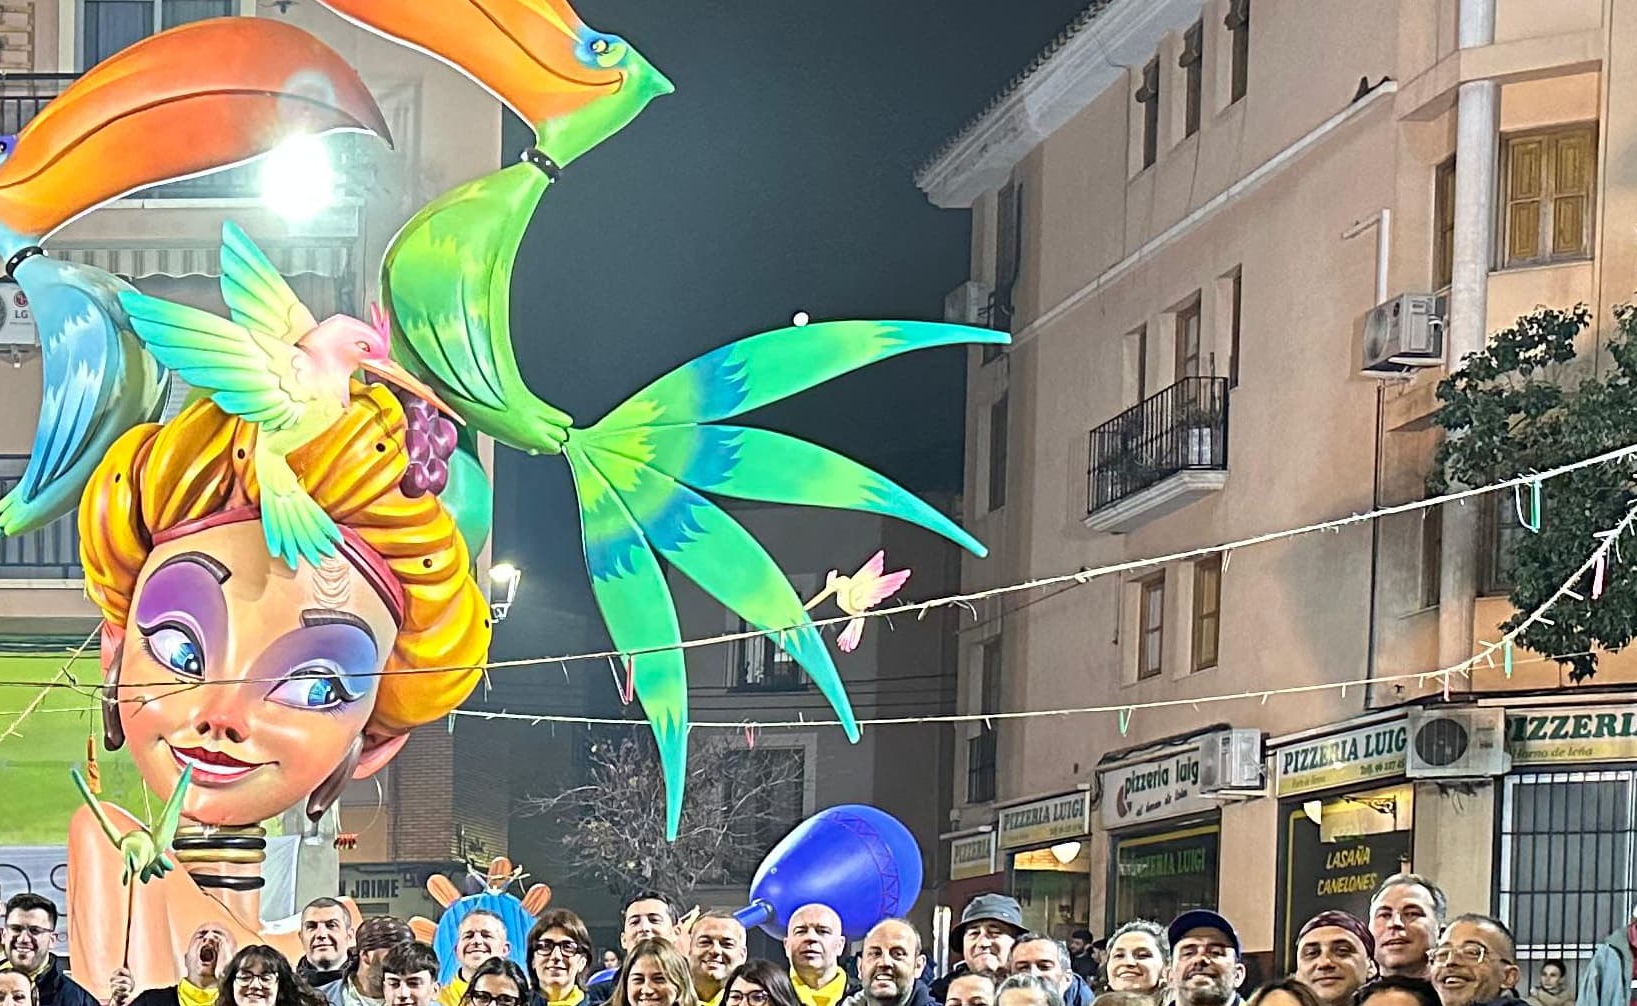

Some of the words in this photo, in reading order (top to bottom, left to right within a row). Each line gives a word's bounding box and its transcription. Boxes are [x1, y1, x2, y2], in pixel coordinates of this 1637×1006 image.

[14, 309, 29, 319] LG
[1506, 712, 1637, 742] IZZERI
[1283, 737, 1359, 775] PIZZERIA
[1364, 726, 1408, 758] LUIG
[1124, 763, 1169, 800] pizzeria
[1176, 756, 1200, 786] luig
[1326, 845, 1371, 870] LASAÑA
[1317, 873, 1377, 896] CANELONES
